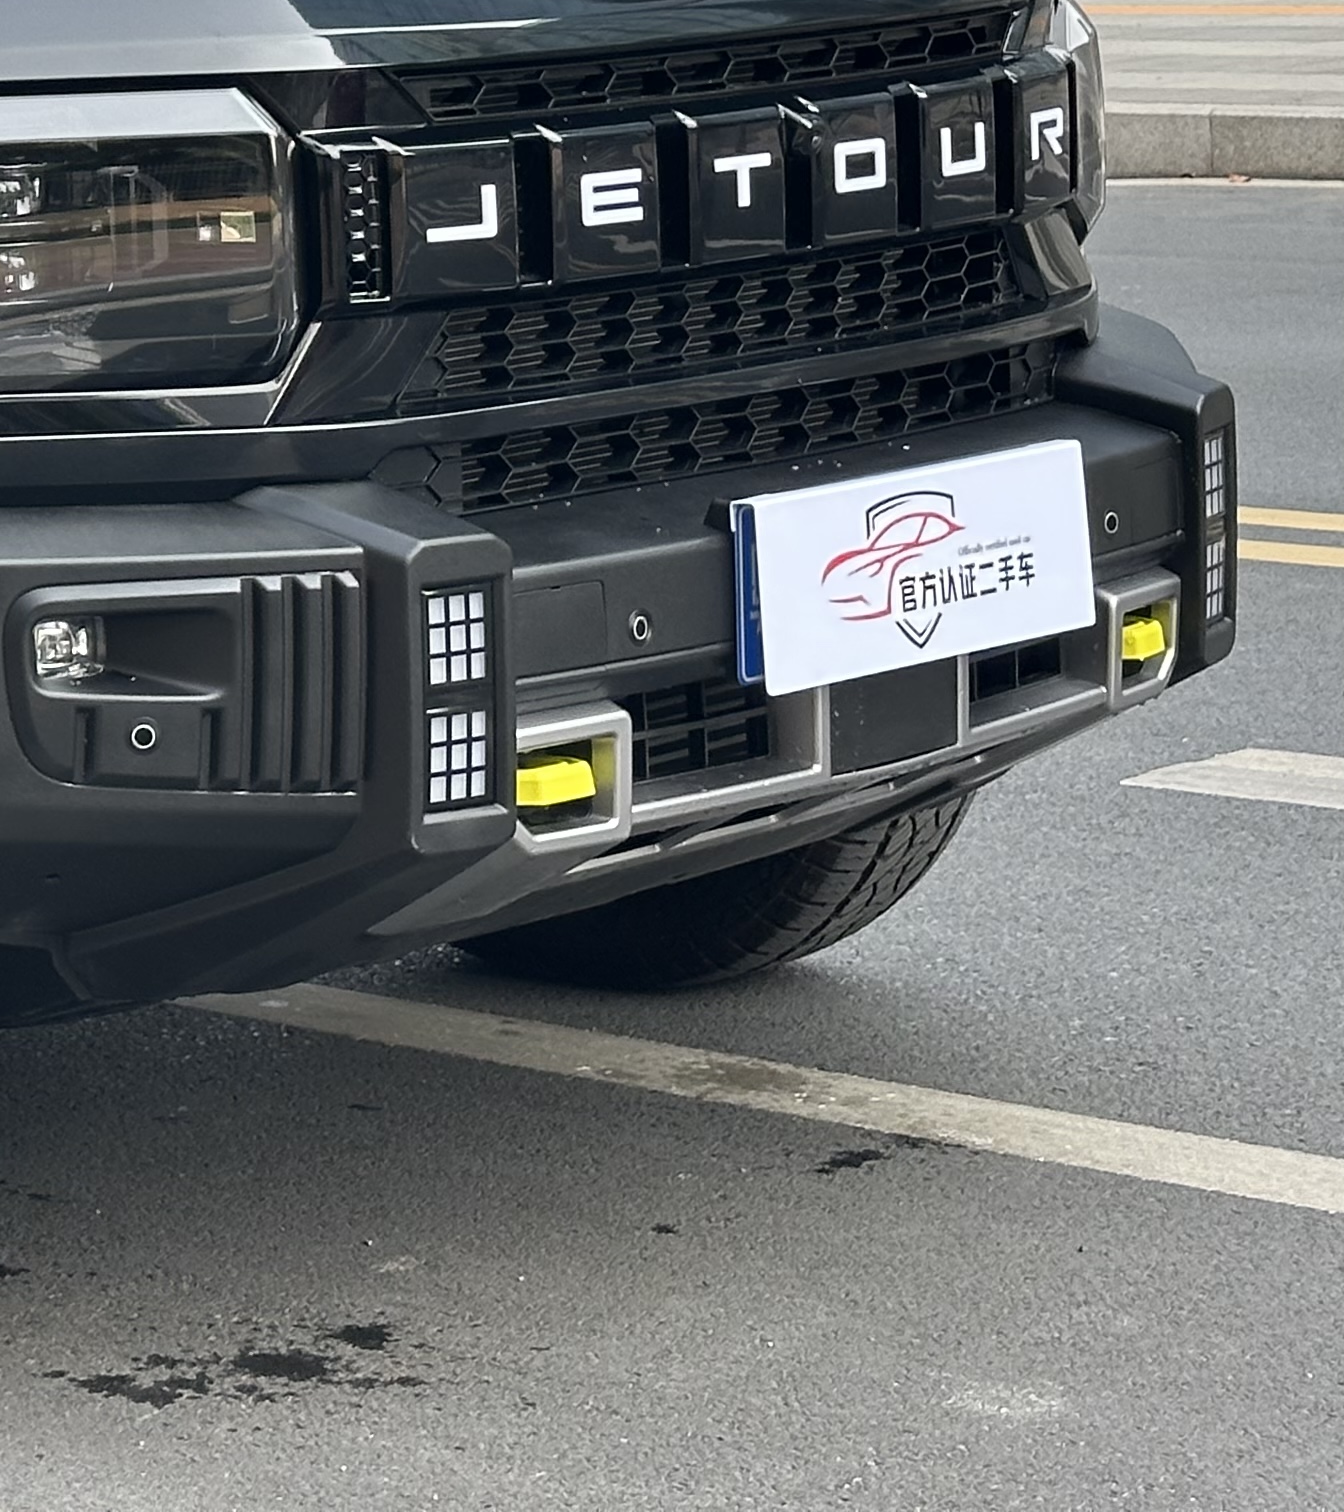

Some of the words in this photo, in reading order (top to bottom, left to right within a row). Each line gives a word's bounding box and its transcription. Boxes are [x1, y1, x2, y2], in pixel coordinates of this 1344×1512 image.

[424, 105, 1065, 244] JETOUR
[898, 551, 1036, 613] 官方认证二手车
